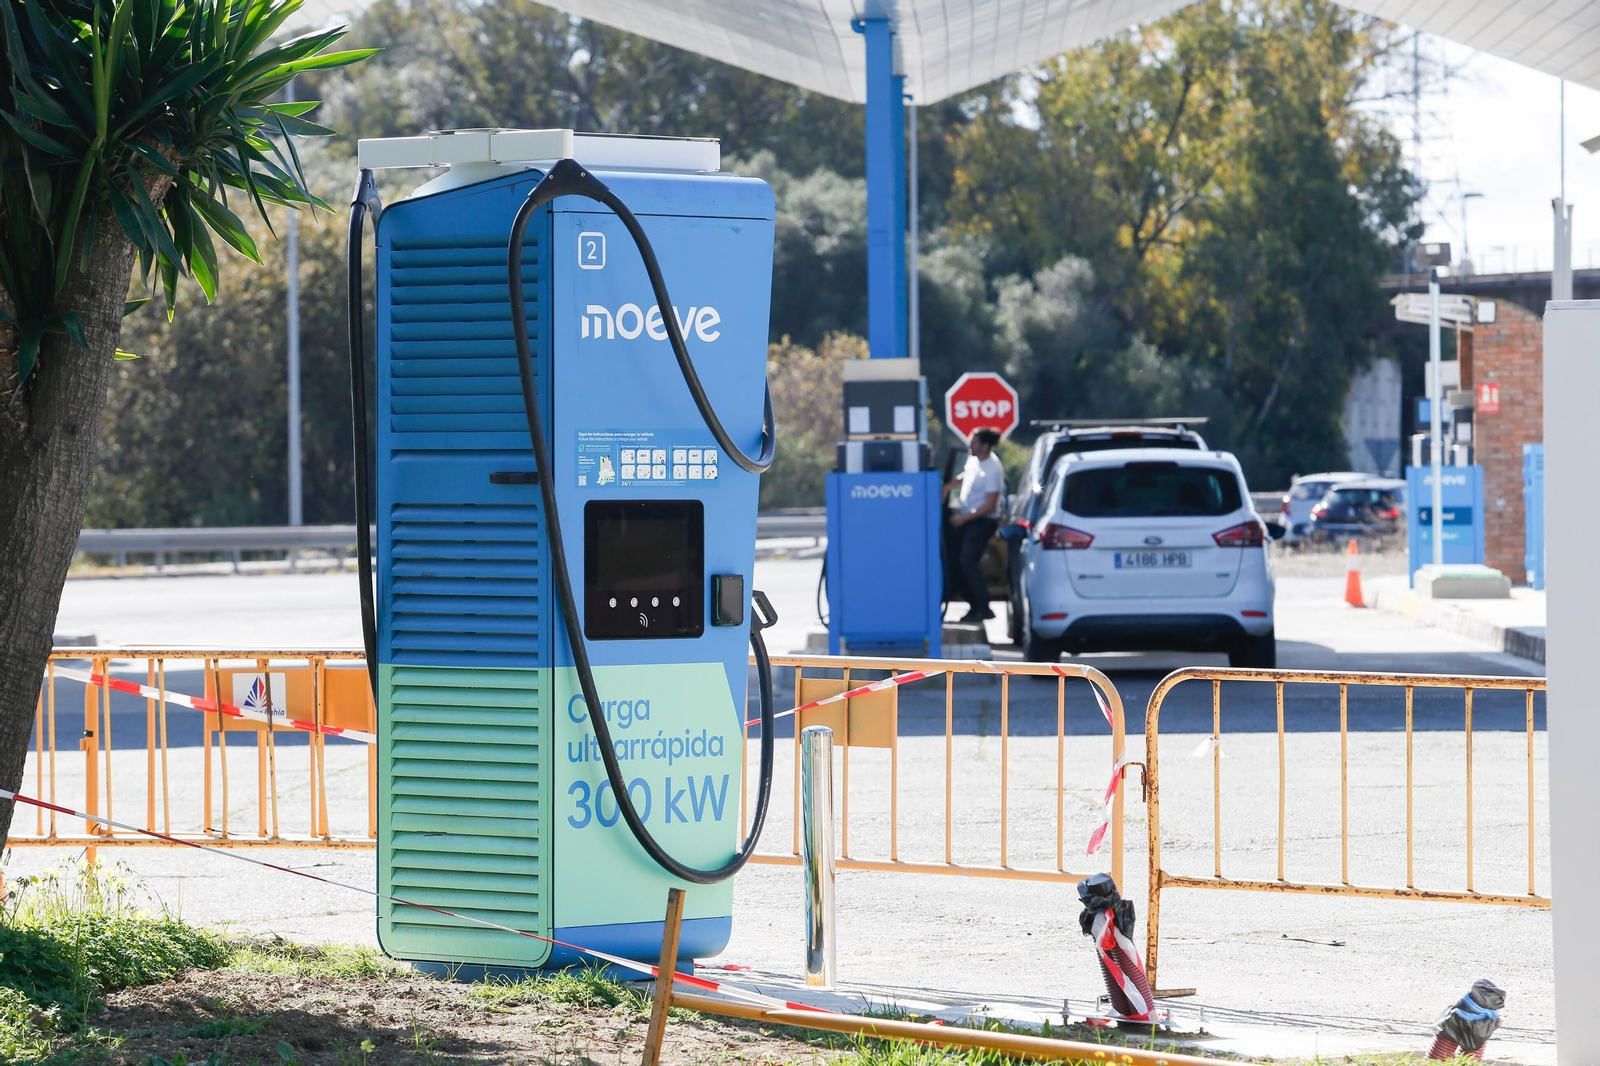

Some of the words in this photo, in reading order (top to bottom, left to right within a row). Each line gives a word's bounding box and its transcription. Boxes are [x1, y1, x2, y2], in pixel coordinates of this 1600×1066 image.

[586, 240, 597, 260] 2
[581, 303, 721, 342] moeve
[954, 400, 1012, 419] STOP
[1423, 474, 1466, 486] meve
[851, 484, 913, 498] moeve
[1126, 552, 1158, 566] 4186
[568, 728, 724, 766] ultarrápida
[567, 777, 652, 829] 300
[665, 774, 730, 824] kW
